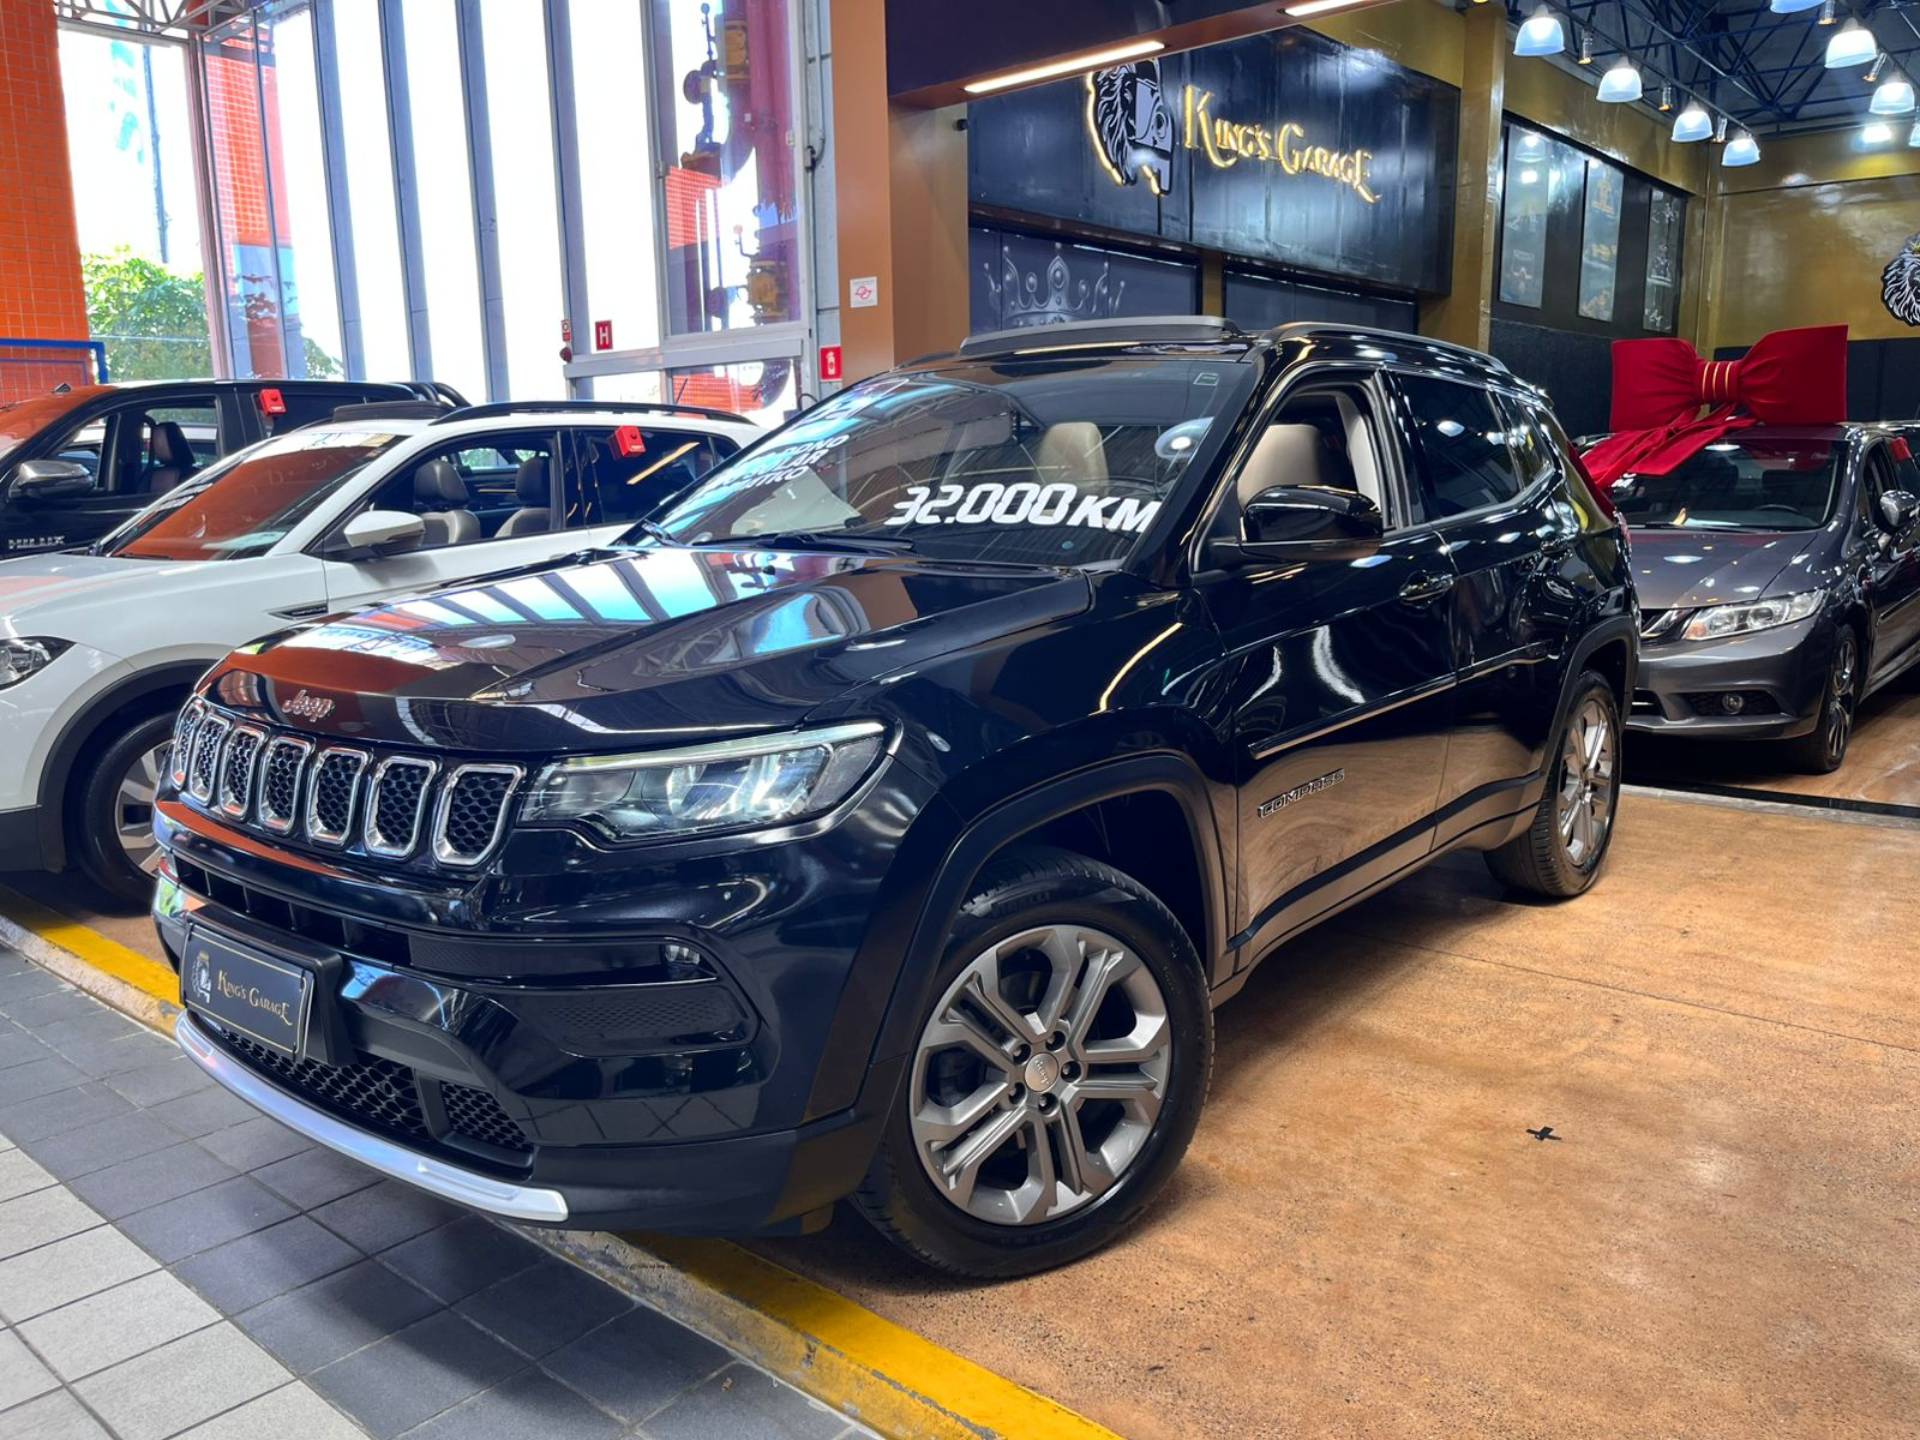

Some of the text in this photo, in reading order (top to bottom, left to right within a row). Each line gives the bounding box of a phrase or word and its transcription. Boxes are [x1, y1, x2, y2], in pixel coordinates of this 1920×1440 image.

[599, 325, 609, 345] H
[281, 689, 335, 723] Jeep
[1257, 768, 1345, 818] COMPASS
